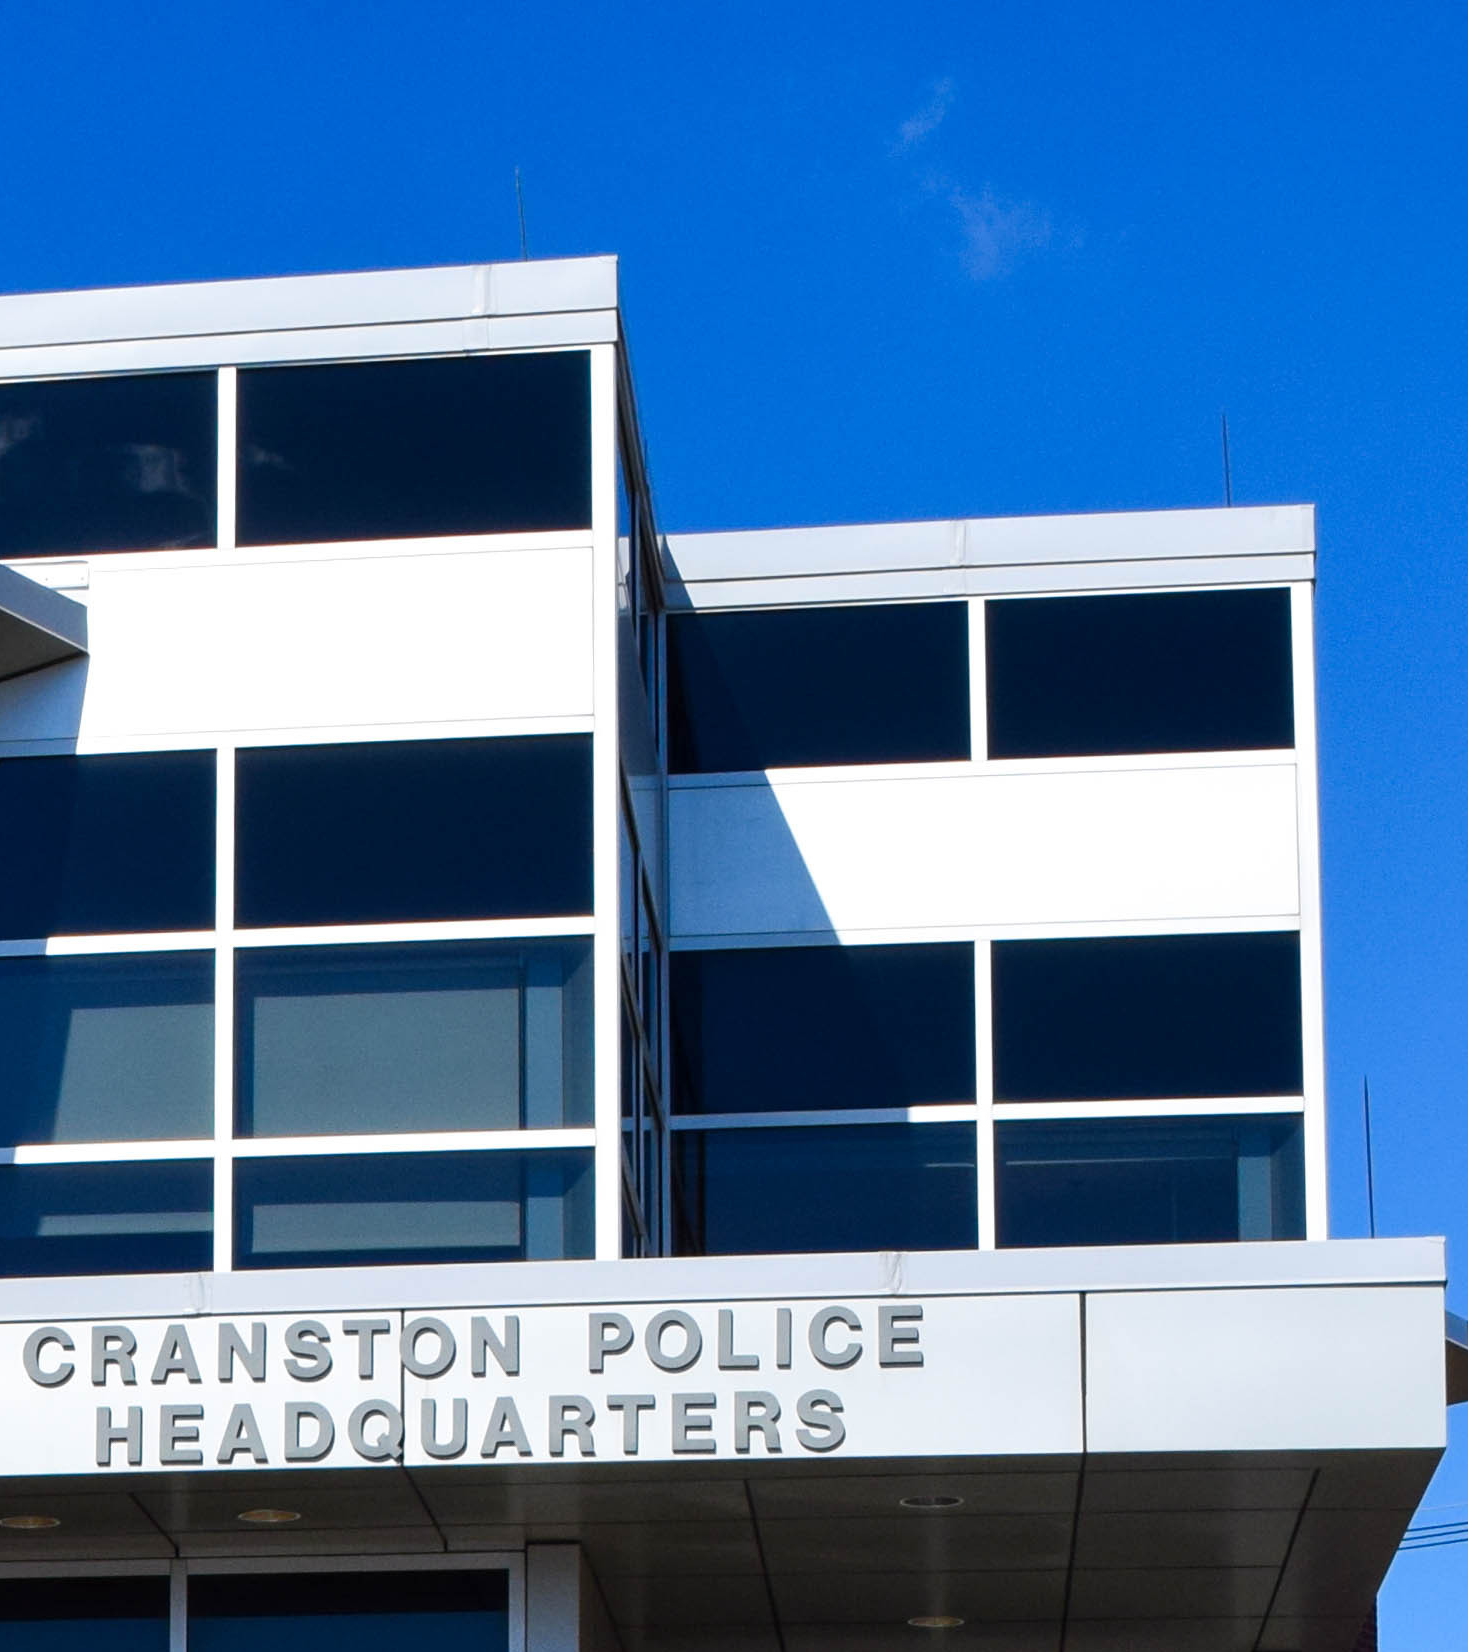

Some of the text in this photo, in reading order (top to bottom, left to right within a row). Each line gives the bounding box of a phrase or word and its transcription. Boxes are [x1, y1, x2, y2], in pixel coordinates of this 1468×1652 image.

[23, 1305, 924, 1388] CRANSTON POLICE
[96, 1389, 847, 1467] HEADQUARTERS
